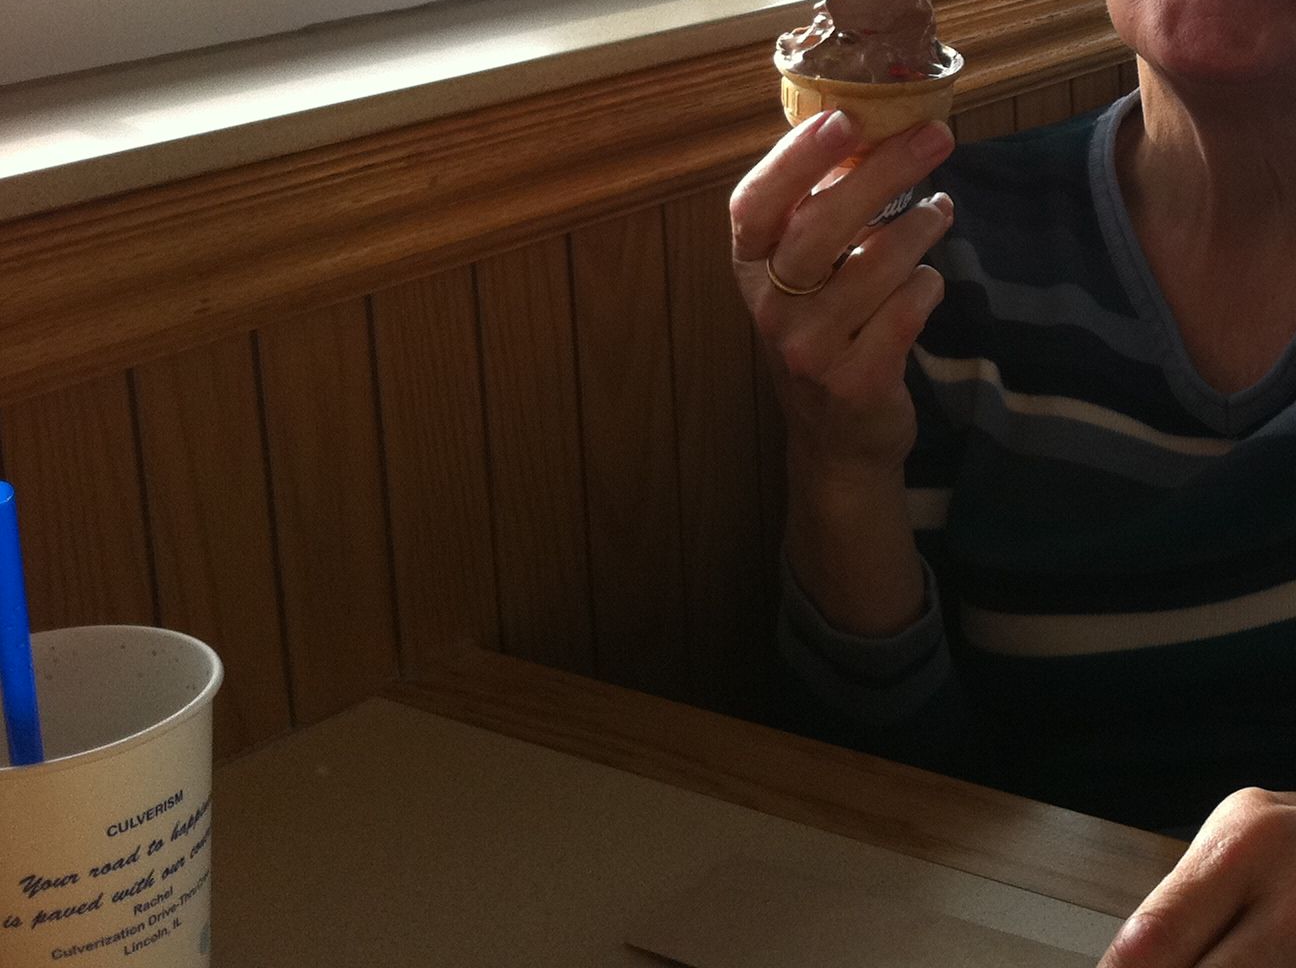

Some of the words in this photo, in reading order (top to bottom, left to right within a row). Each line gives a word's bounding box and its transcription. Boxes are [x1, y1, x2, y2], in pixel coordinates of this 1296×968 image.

[106, 789, 184, 837] CULVERISM
[19, 874, 80, 899] Your
[89, 845, 141, 878] road
[147, 838, 164, 857] to
[3, 914, 23, 929] is
[31, 893, 103, 930] paved
[111, 869, 156, 904] with
[161, 856, 185, 882] our
[133, 886, 174, 916] Rachel
[51, 922, 145, 960] Culverization
[124, 924, 171, 956] Lincoln,
[172, 919, 183, 930] IL
